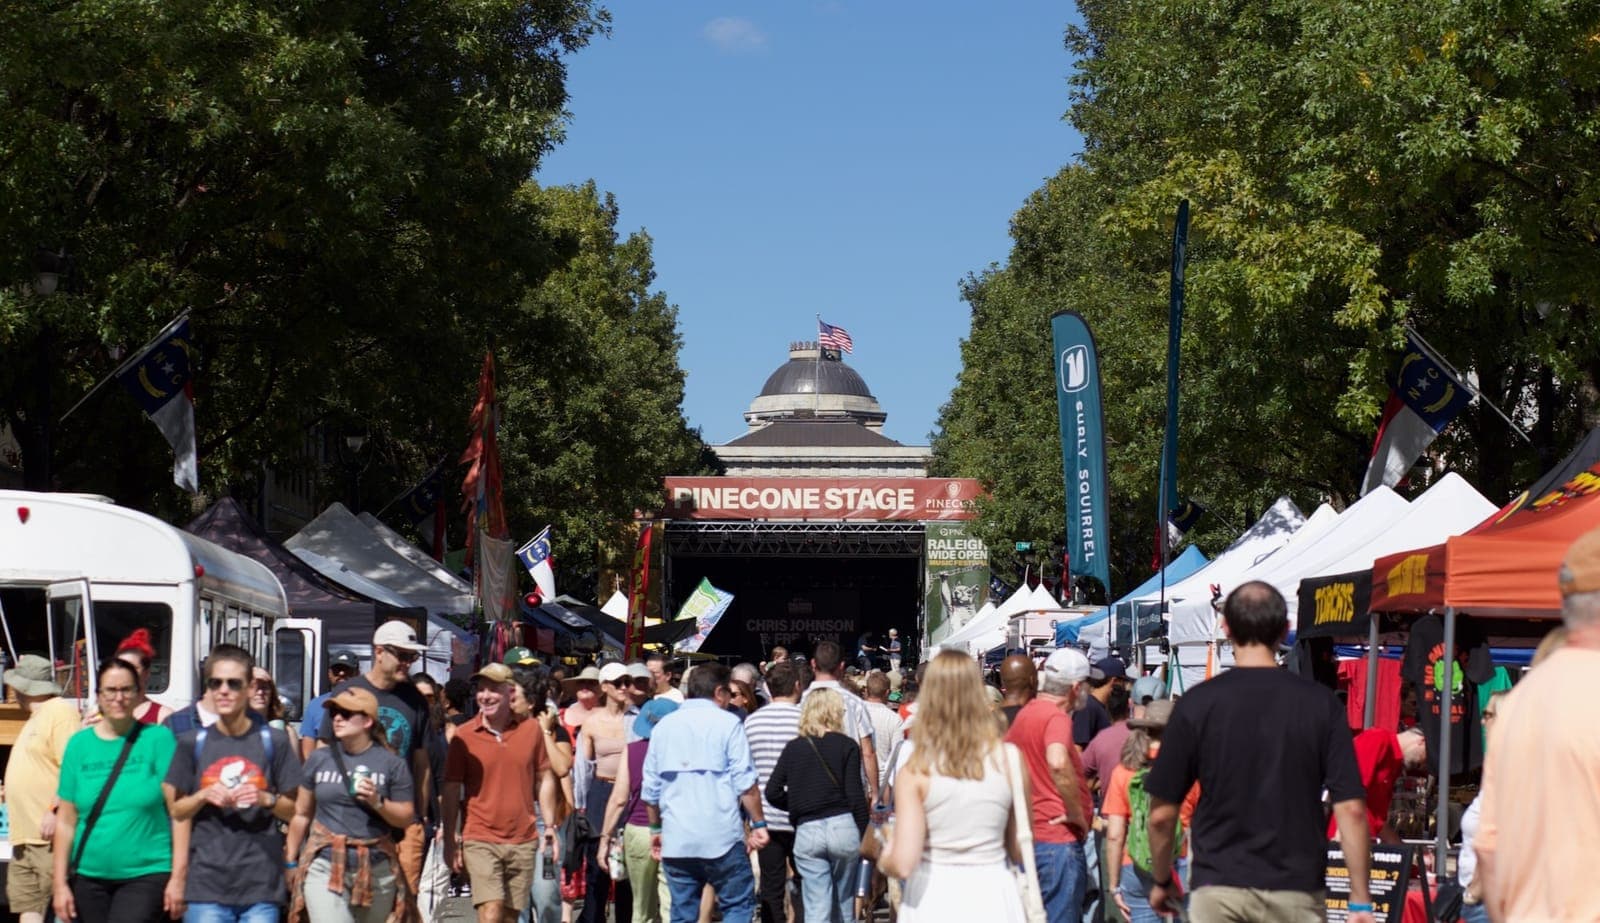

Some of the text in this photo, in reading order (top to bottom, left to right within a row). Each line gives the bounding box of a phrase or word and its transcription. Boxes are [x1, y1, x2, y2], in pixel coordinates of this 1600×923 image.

[674, 487, 915, 510] PINECONE STAGE
[1079, 469, 1095, 562] SQUIRREL
[928, 551, 988, 560] WIDE OPEN
[746, 619, 855, 632] CHRIS JOHNSON
